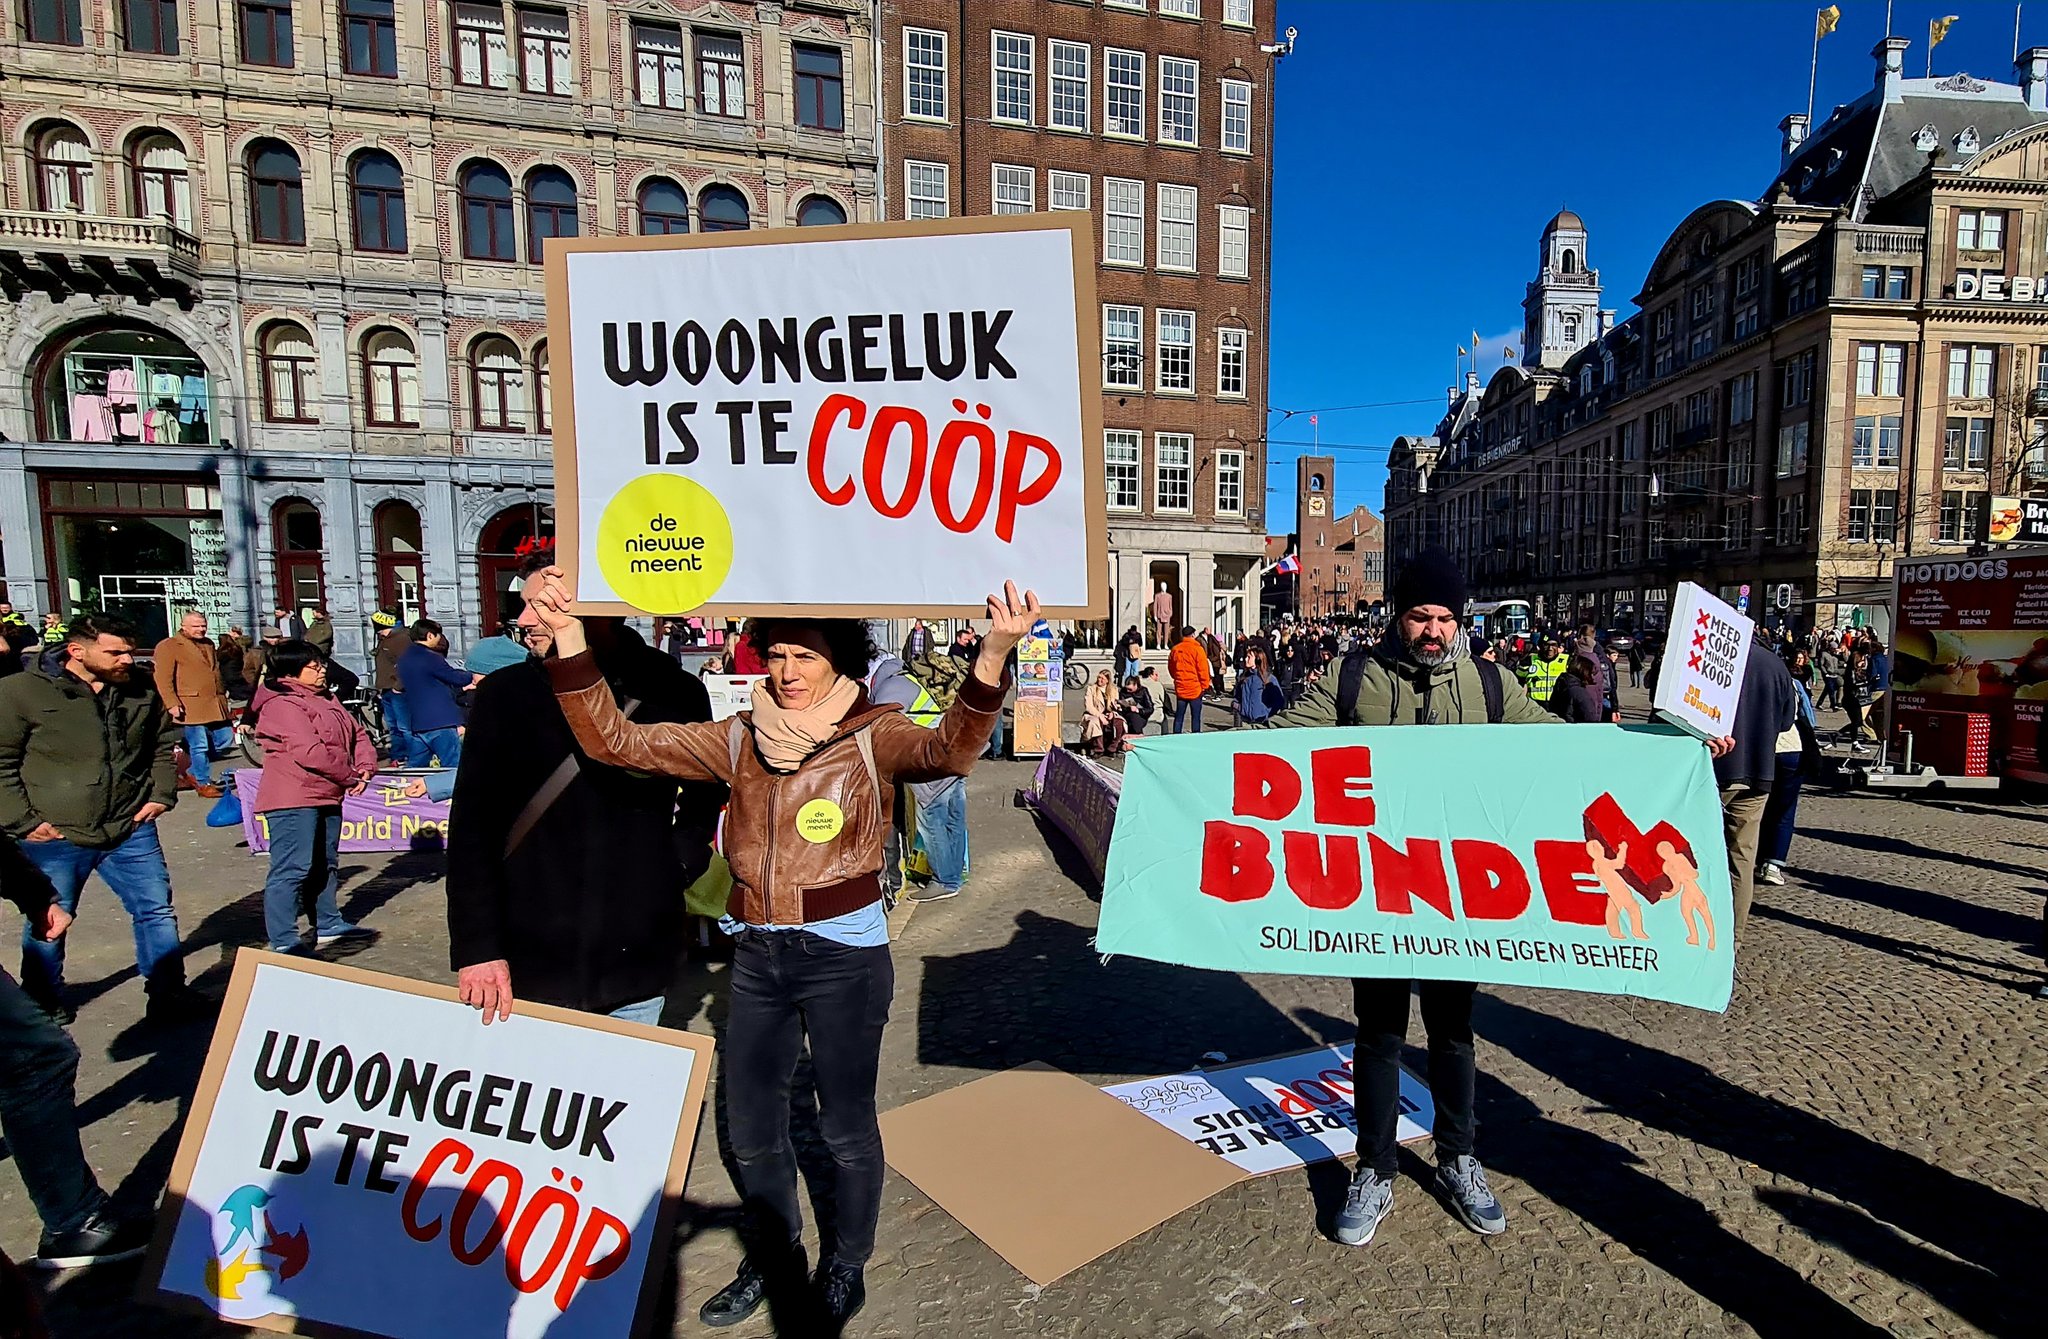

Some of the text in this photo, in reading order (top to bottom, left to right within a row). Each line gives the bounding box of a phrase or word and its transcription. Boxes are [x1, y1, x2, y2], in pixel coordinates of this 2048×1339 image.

[1955, 273, 2048, 301] DE BI
[602, 310, 1018, 387] WOONGELUK
[643, 393, 1062, 543] IS TE COÖP
[650, 512, 677, 532] de
[2026, 503, 2048, 519] Br
[625, 533, 705, 553] nieuwe
[630, 553, 703, 573] meent
[1902, 559, 2009, 584] HOTDOGS
[2013, 570, 2033, 579] AND
[1710, 615, 1741, 647] MEER
[1704, 647, 1735, 675] MINDER
[1708, 632, 1738, 661] COÖP
[1701, 660, 1732, 689] KOOP
[1232, 745, 1376, 827] DE
[339, 815, 392, 840] orld
[1259, 926, 1660, 973] SOLIDAIRE HUUR IN EIGEN BEHEER
[253, 1030, 629, 1163] WOONGELUK
[1193, 1103, 1282, 1134] HUIS
[1195, 1131, 1248, 1155] EE
[259, 1109, 632, 1313] IS TE COÖP
